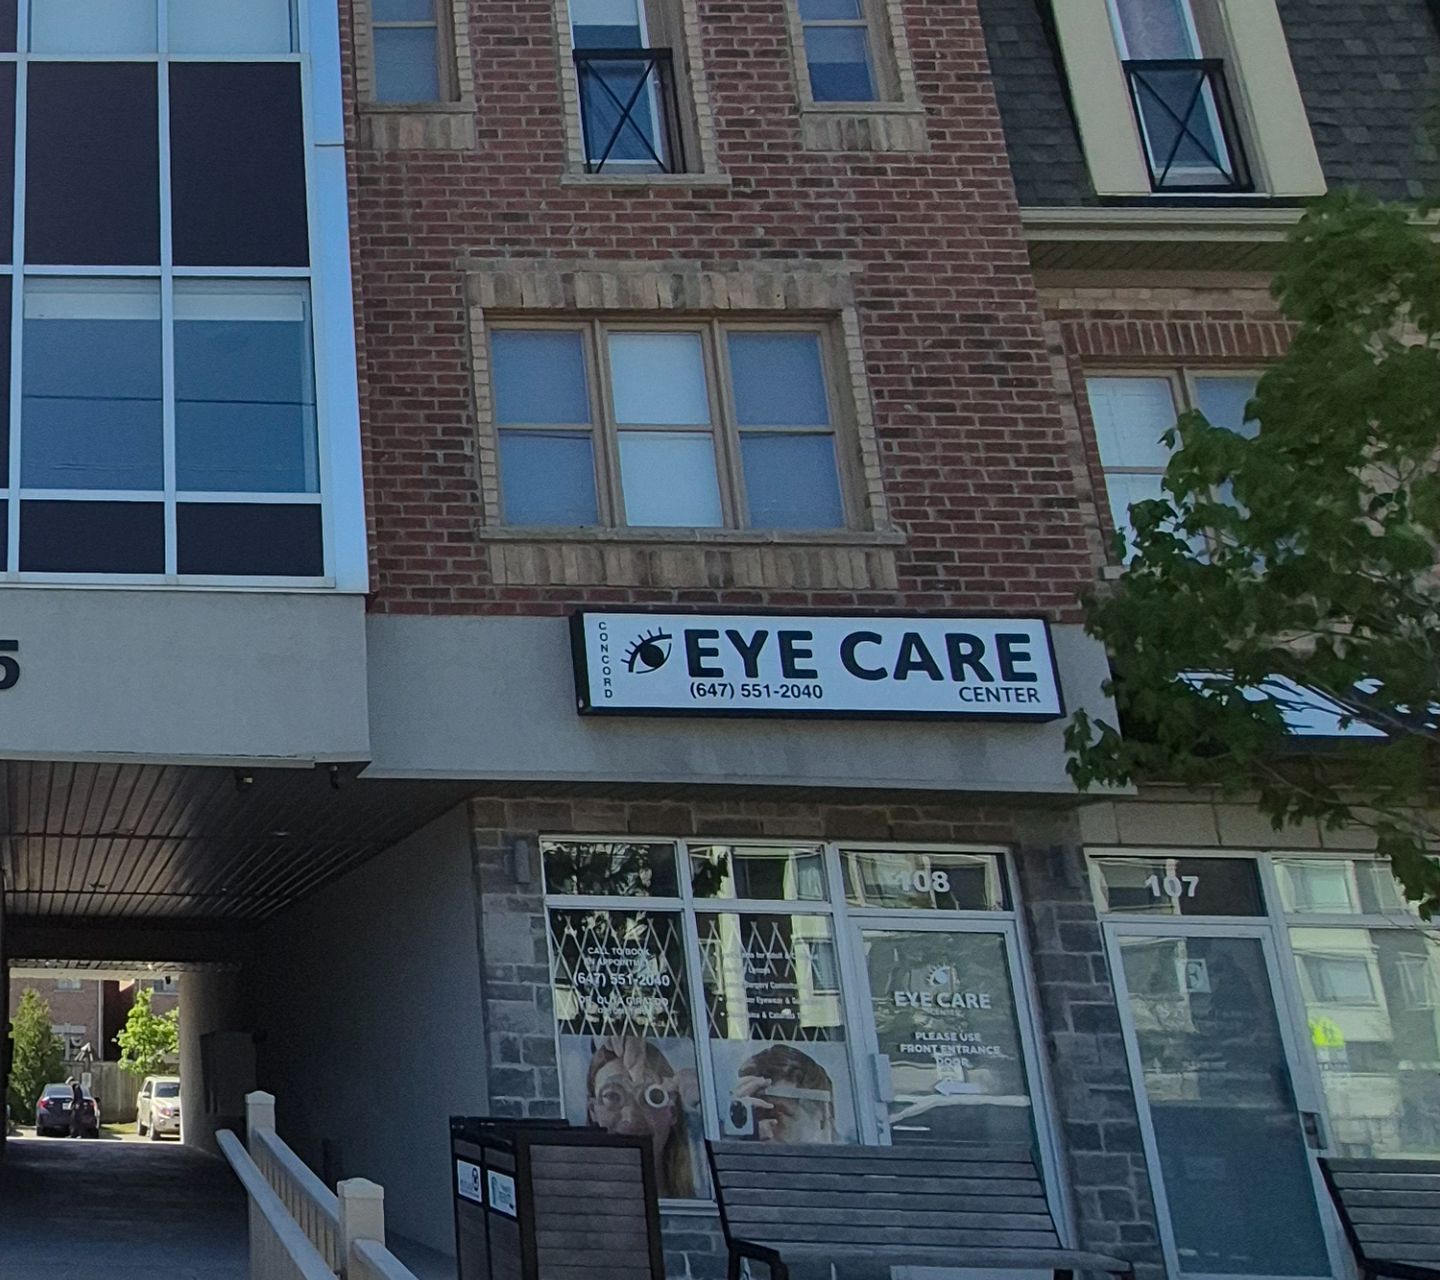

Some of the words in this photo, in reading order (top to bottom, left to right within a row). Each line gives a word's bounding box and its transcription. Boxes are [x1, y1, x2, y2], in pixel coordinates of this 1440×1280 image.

[598, 621, 613, 699] CONCORD
[684, 629, 818, 679] EYE
[840, 631, 1038, 683] CARE
[690, 682, 735, 700] (647)
[741, 684, 823, 699] 551-2040
[959, 686, 1041, 703] CENTER
[896, 869, 951, 894] 108
[1144, 875, 1200, 898] 107
[587, 946, 610, 956] CALL
[894, 990, 933, 1008] EYE
[936, 991, 992, 1009] CARE
[915, 1031, 958, 1041] PLEASE
[959, 1031, 981, 1042] USE
[900, 1043, 938, 1053] FRONT
[940, 1044, 1000, 1055] ENTRANCE
